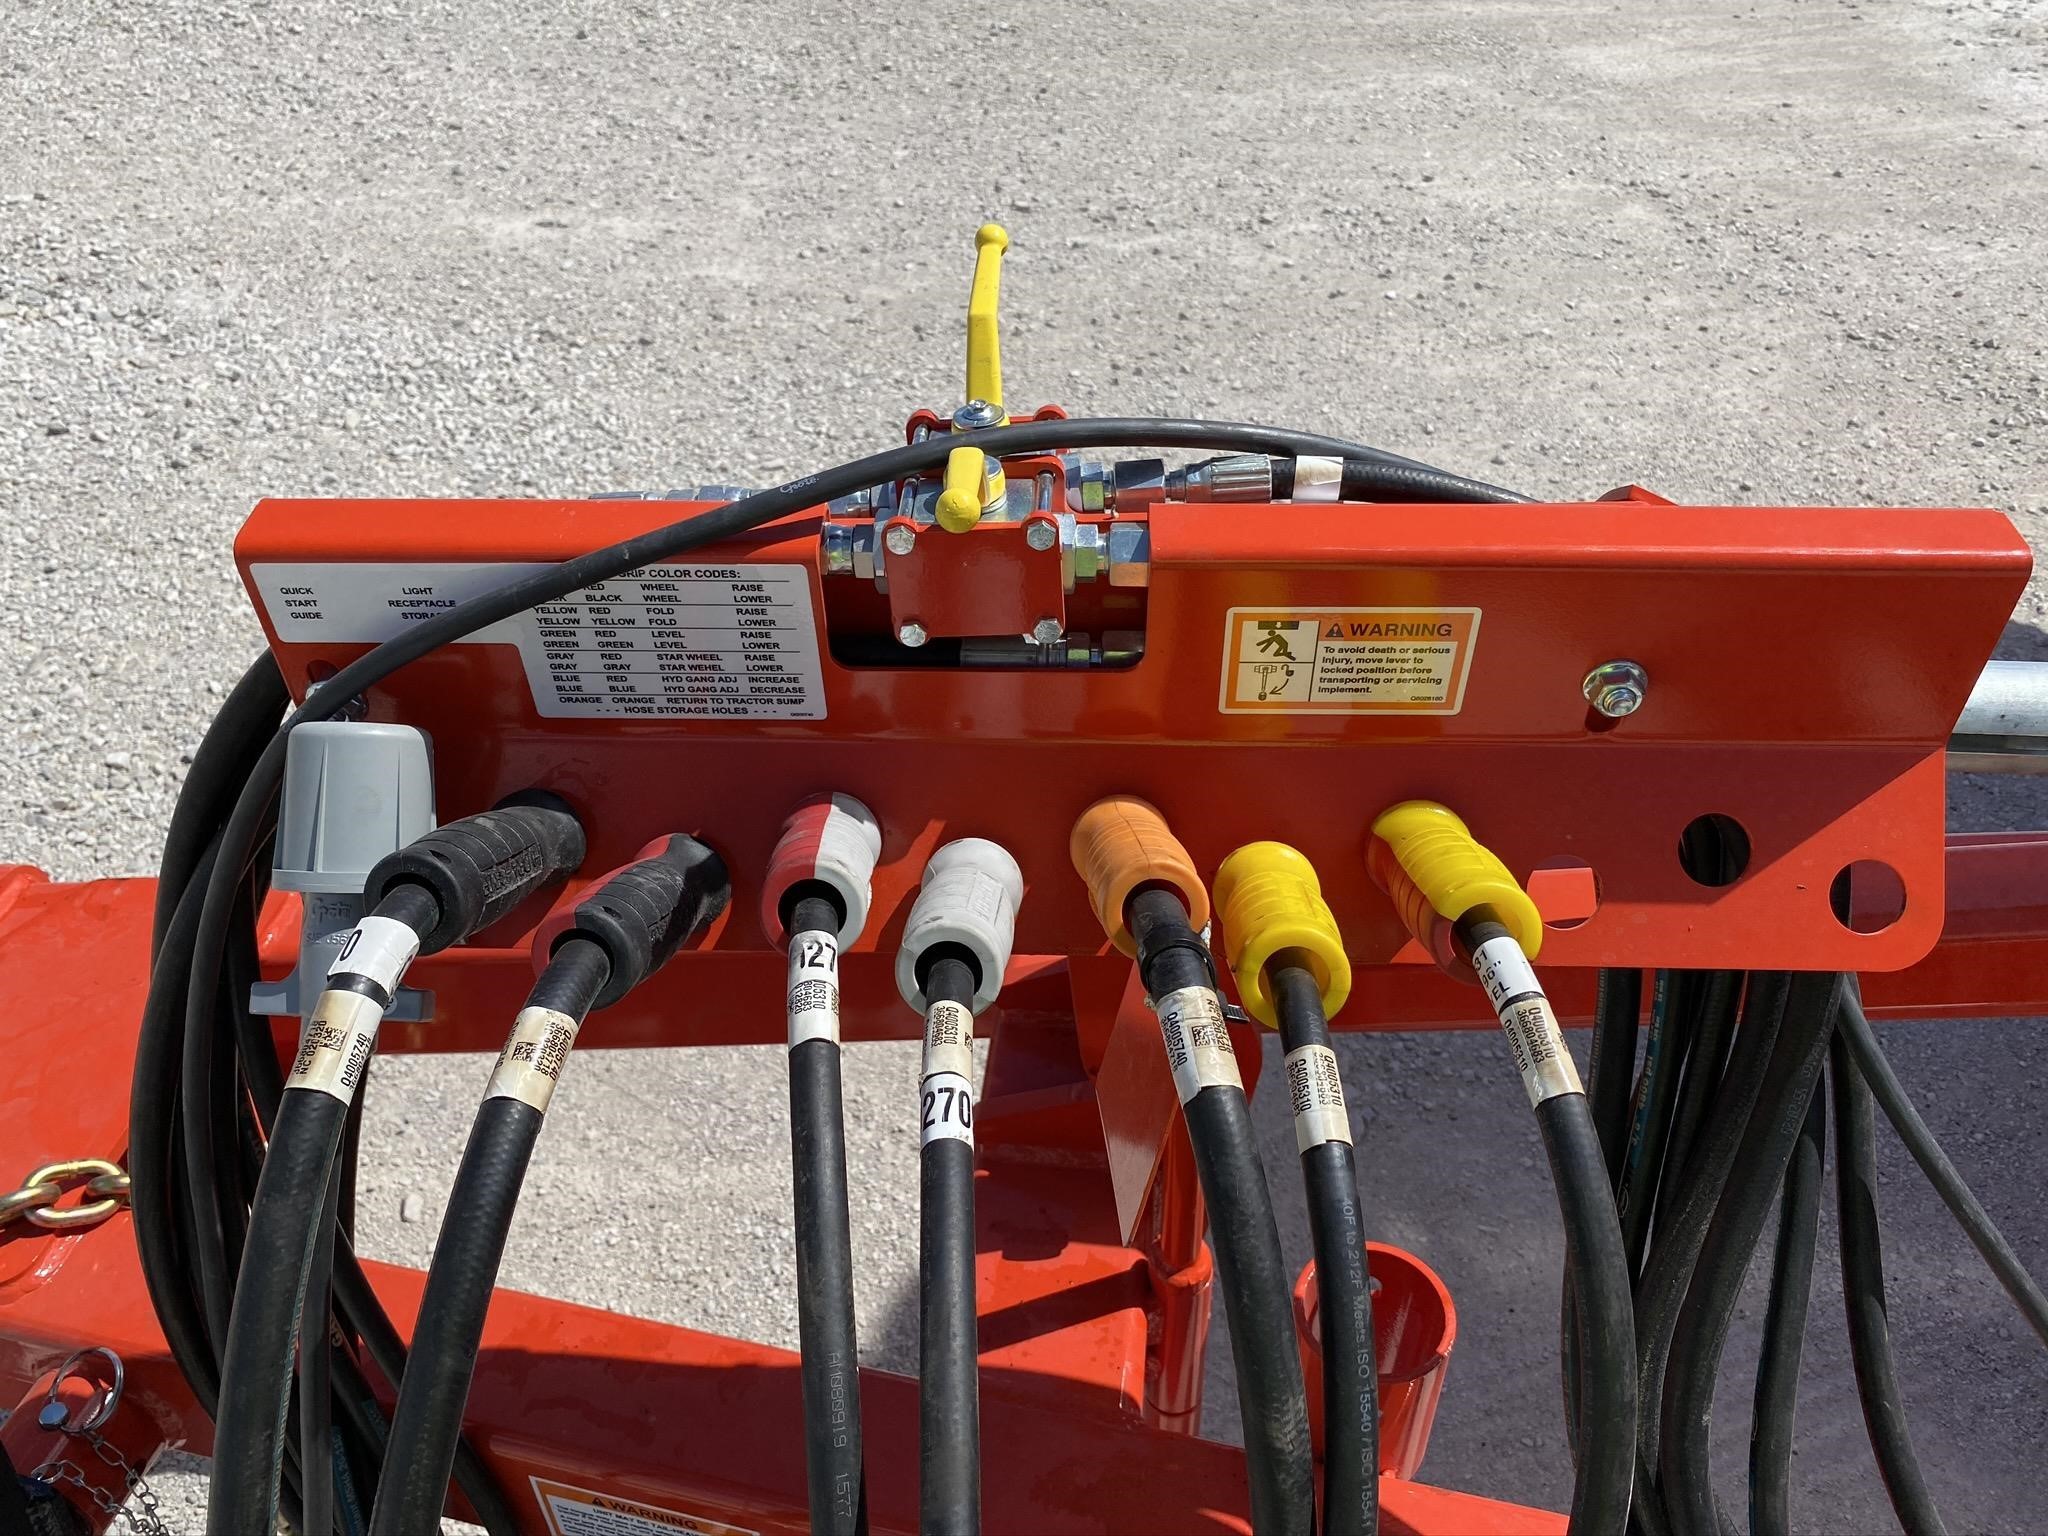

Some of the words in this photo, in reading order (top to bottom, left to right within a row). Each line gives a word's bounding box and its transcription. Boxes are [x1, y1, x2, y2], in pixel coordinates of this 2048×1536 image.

[648, 569, 692, 579] COLOR
[695, 569, 741, 579] CODES:
[280, 587, 314, 595] QUICK
[402, 587, 433, 595] LIGHT
[640, 584, 679, 592] WHEEL
[732, 584, 764, 592] RAISE
[585, 594, 623, 602] BLACK
[642, 594, 682, 603] WHEEL
[734, 595, 772, 603] LOWER
[388, 600, 456, 608] RECEPTACLE
[291, 612, 323, 620] GUIDE
[534, 607, 578, 615] YELLOW
[588, 607, 611, 615] RED
[646, 607, 675, 615] FOLD
[736, 608, 768, 616] RAISE
[536, 617, 581, 626] YELLOW
[591, 618, 636, 626] YELLOW
[648, 618, 677, 626] FOLD
[738, 619, 777, 627] LOWER
[540, 630, 577, 638] GREEN
[594, 630, 617, 638] RED
[740, 631, 772, 639] RAISE
[1350, 623, 1453, 637] WARNING
[742, 642, 780, 650] LOWER
[1323, 646, 1336, 654] To
[1337, 646, 1366, 654] avoid
[1367, 646, 1396, 654] death
[1412, 646, 1451, 654] serious
[744, 654, 776, 662] RAISE
[1322, 656, 1353, 666] injury,
[1385, 656, 1411, 664] lever
[1413, 656, 1424, 664] to
[549, 663, 578, 671] GRAY
[688, 664, 725, 672] WEHEL
[746, 664, 784, 672] LOWER
[1320, 666, 1354, 674] locked
[1356, 666, 1398, 676] position
[1399, 666, 1433, 674] before
[748, 676, 800, 684] INCREASE
[1318, 676, 1381, 685] transporting
[1395, 676, 1442, 685] servicing
[750, 686, 806, 694] DECREASE
[1317, 686, 1372, 695] implement.
[559, 696, 603, 704] ORANGE
[612, 696, 656, 704] ORANGE
[624, 706, 656, 714] HOSE
[657, 706, 710, 714] STORAGE
[712, 707, 748, 715] HOLES
[944, 1006, 958, 1045] Q4005310
[1166, 1011, 1188, 1066] Q4005740
[1516, 1010, 1544, 1063] 366804683
[541, 1023, 565, 1077] 366804718
[341, 1032, 368, 1088] Q4005740
[1294, 1058, 1312, 1112] Q4005310
[1324, 1054, 1342, 1107] Q4005310
[922, 1087, 971, 1131] 270
[1346, 1231, 1356, 1246] to
[1348, 1250, 1364, 1290] 212F
[1356, 1348, 1370, 1379] ISO
[1358, 1384, 1372, 1432] 15540
[1361, 1447, 1373, 1476] ISO
[836, 1472, 852, 1517] 1577
[608, 1501, 699, 1530] WARNING
